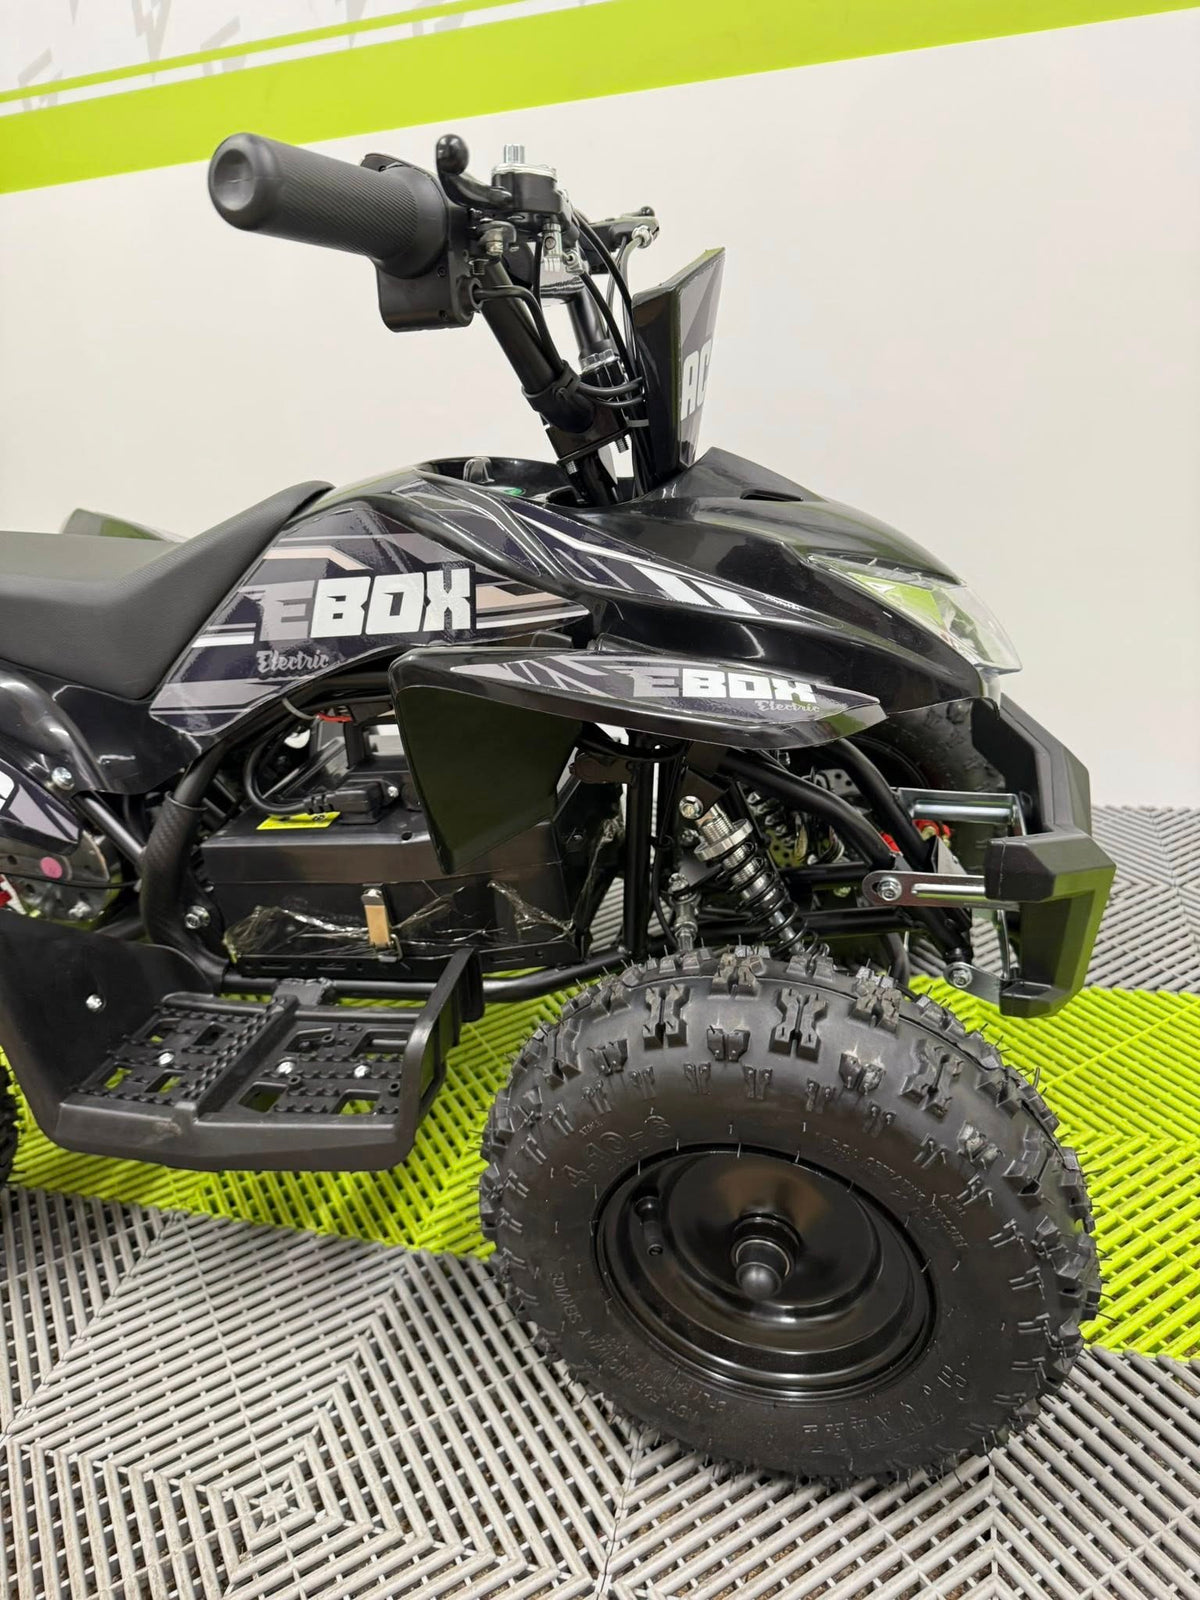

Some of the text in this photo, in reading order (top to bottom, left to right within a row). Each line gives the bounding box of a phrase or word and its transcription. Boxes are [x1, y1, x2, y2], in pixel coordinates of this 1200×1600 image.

[240, 568, 471, 641] EBOX
[257, 649, 329, 674] Electric
[604, 667, 817, 702] EBOX
[757, 701, 820, 712] Electric
